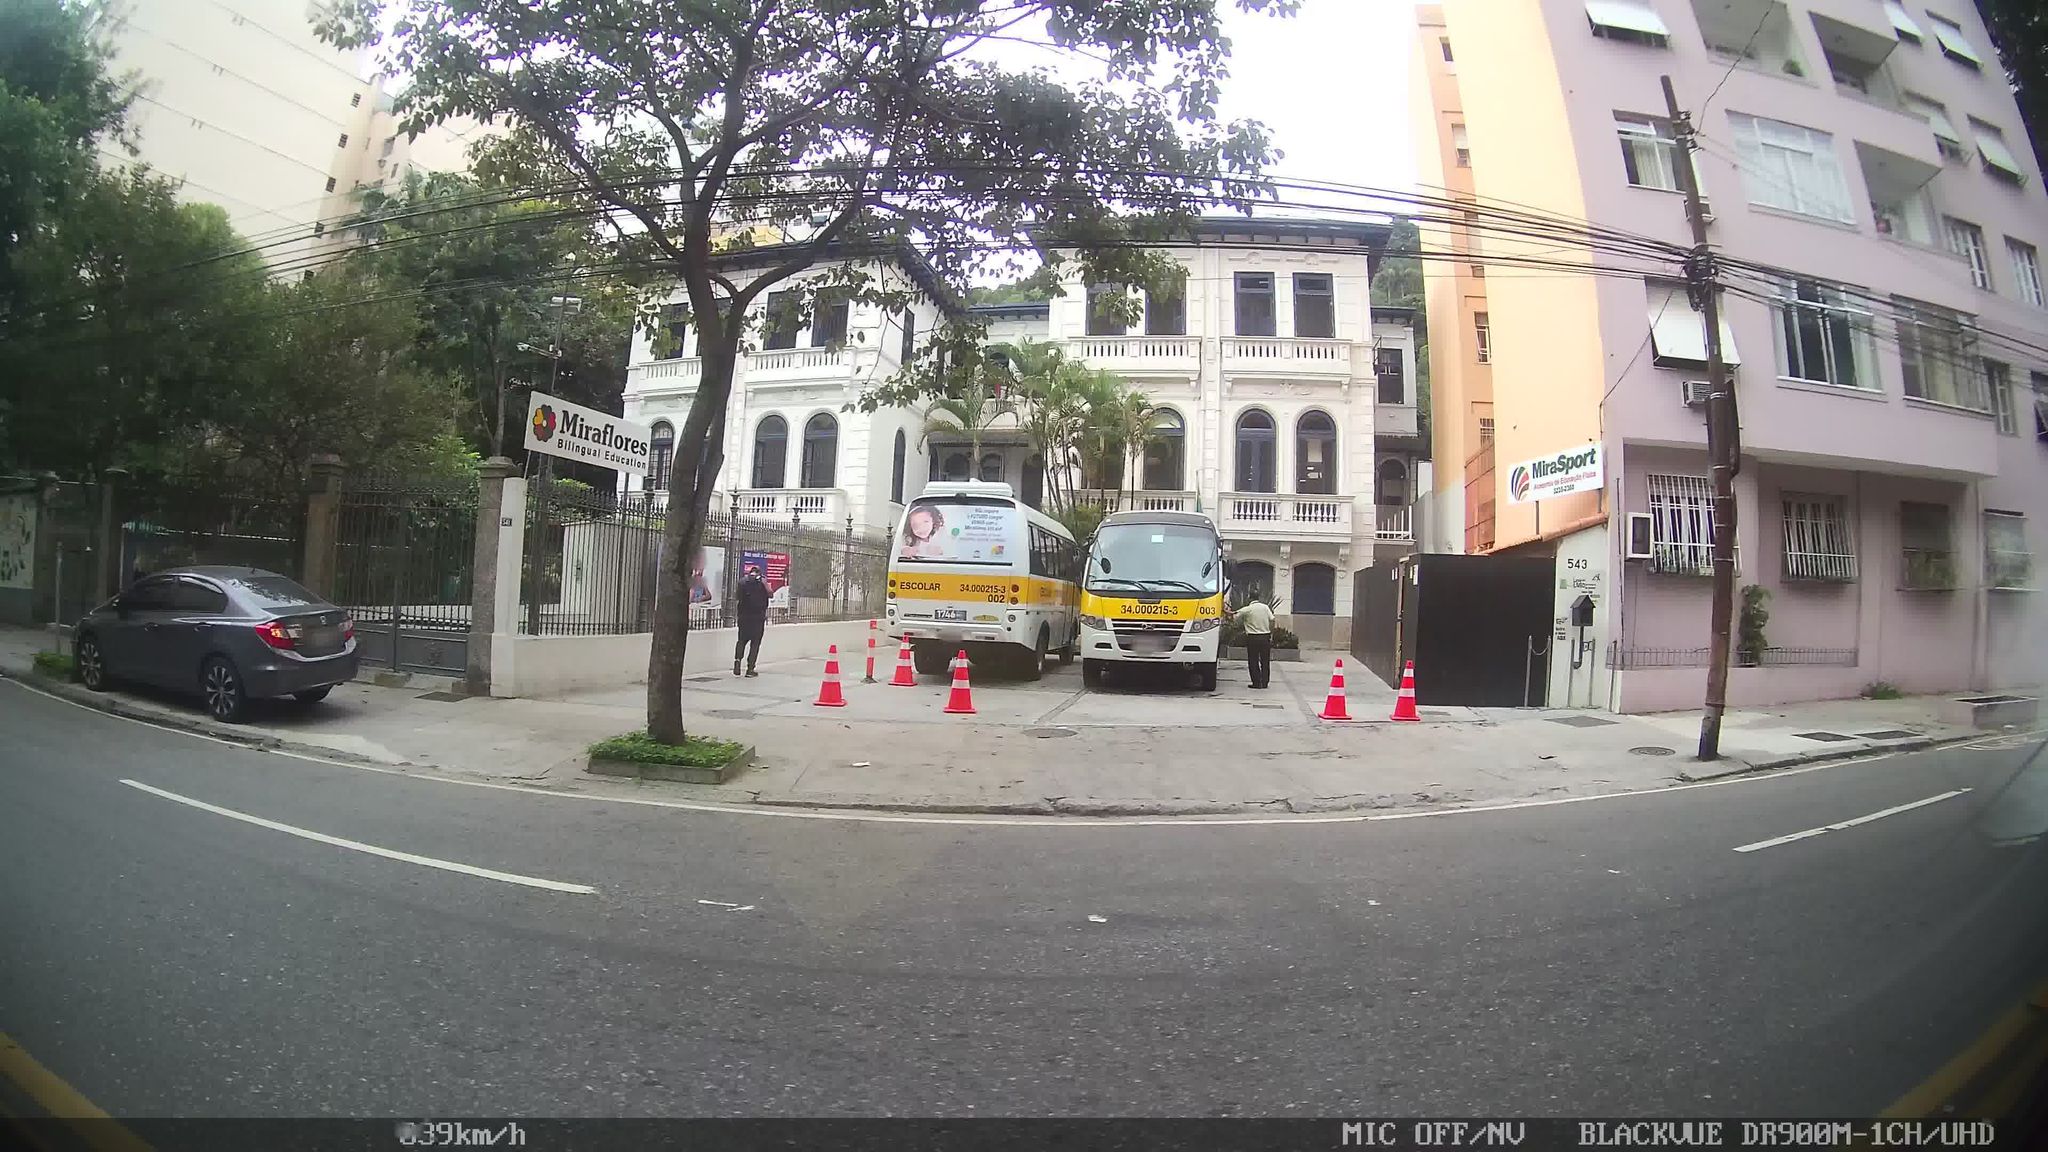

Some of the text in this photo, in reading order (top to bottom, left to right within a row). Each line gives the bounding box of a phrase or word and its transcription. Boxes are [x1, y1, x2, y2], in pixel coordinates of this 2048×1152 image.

[560, 410, 648, 456] Miraflores
[557, 438, 646, 469] Bilingual Education
[1532, 448, 1596, 479] MiraSport
[1567, 558, 1588, 570] 543
[900, 581, 1006, 594] ESCOLAR 34.000215-3
[987, 594, 1005, 604] 002
[1120, 604, 1216, 615] 34.000215-3 003
